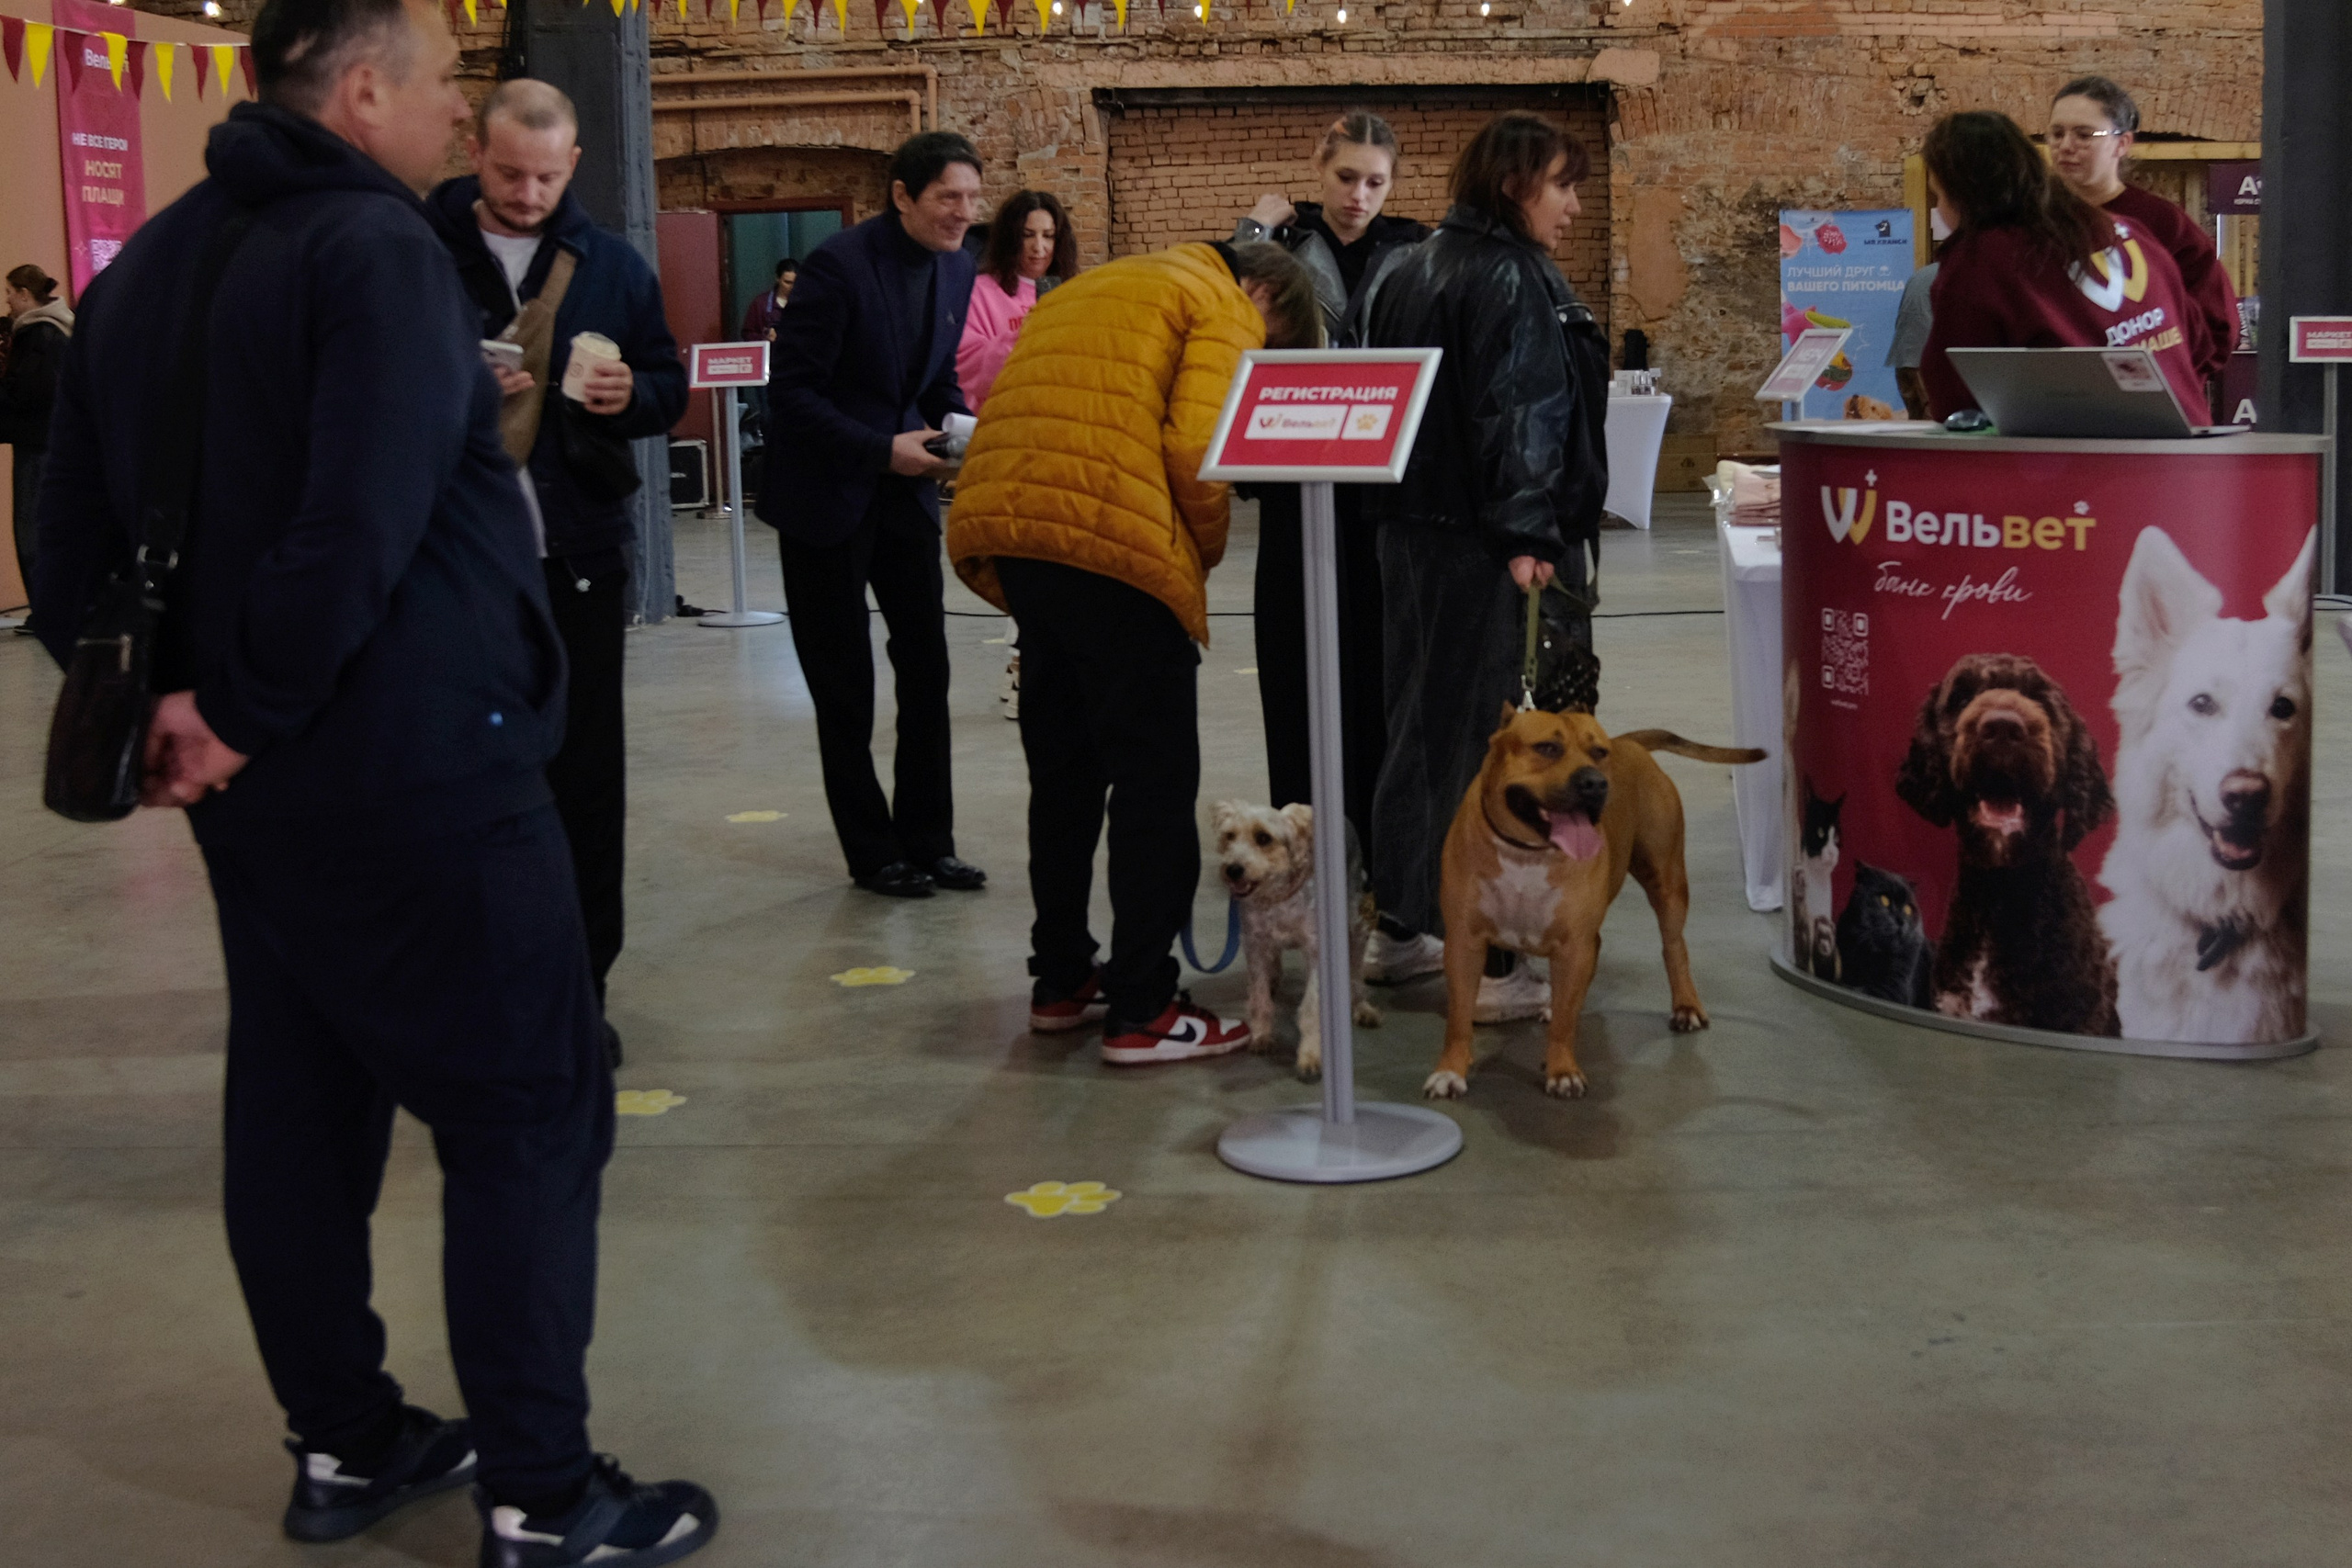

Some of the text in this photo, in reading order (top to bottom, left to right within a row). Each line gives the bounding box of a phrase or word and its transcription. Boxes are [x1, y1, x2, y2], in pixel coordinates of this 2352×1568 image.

[85, 160, 122, 179] НОСЯТ
[82, 186, 125, 208] ПЛАЩИ
[1788, 265, 1875, 278] ЛУЧШИЙ ДРУГ
[1788, 280, 1905, 292] ВАШЕГО ПИТОМЦА
[2105, 307, 2165, 347] ДОНОР
[1259, 386, 1398, 402] РЕГИСТРАЦИЯ
[1885, 500, 2098, 551] Вельвет
